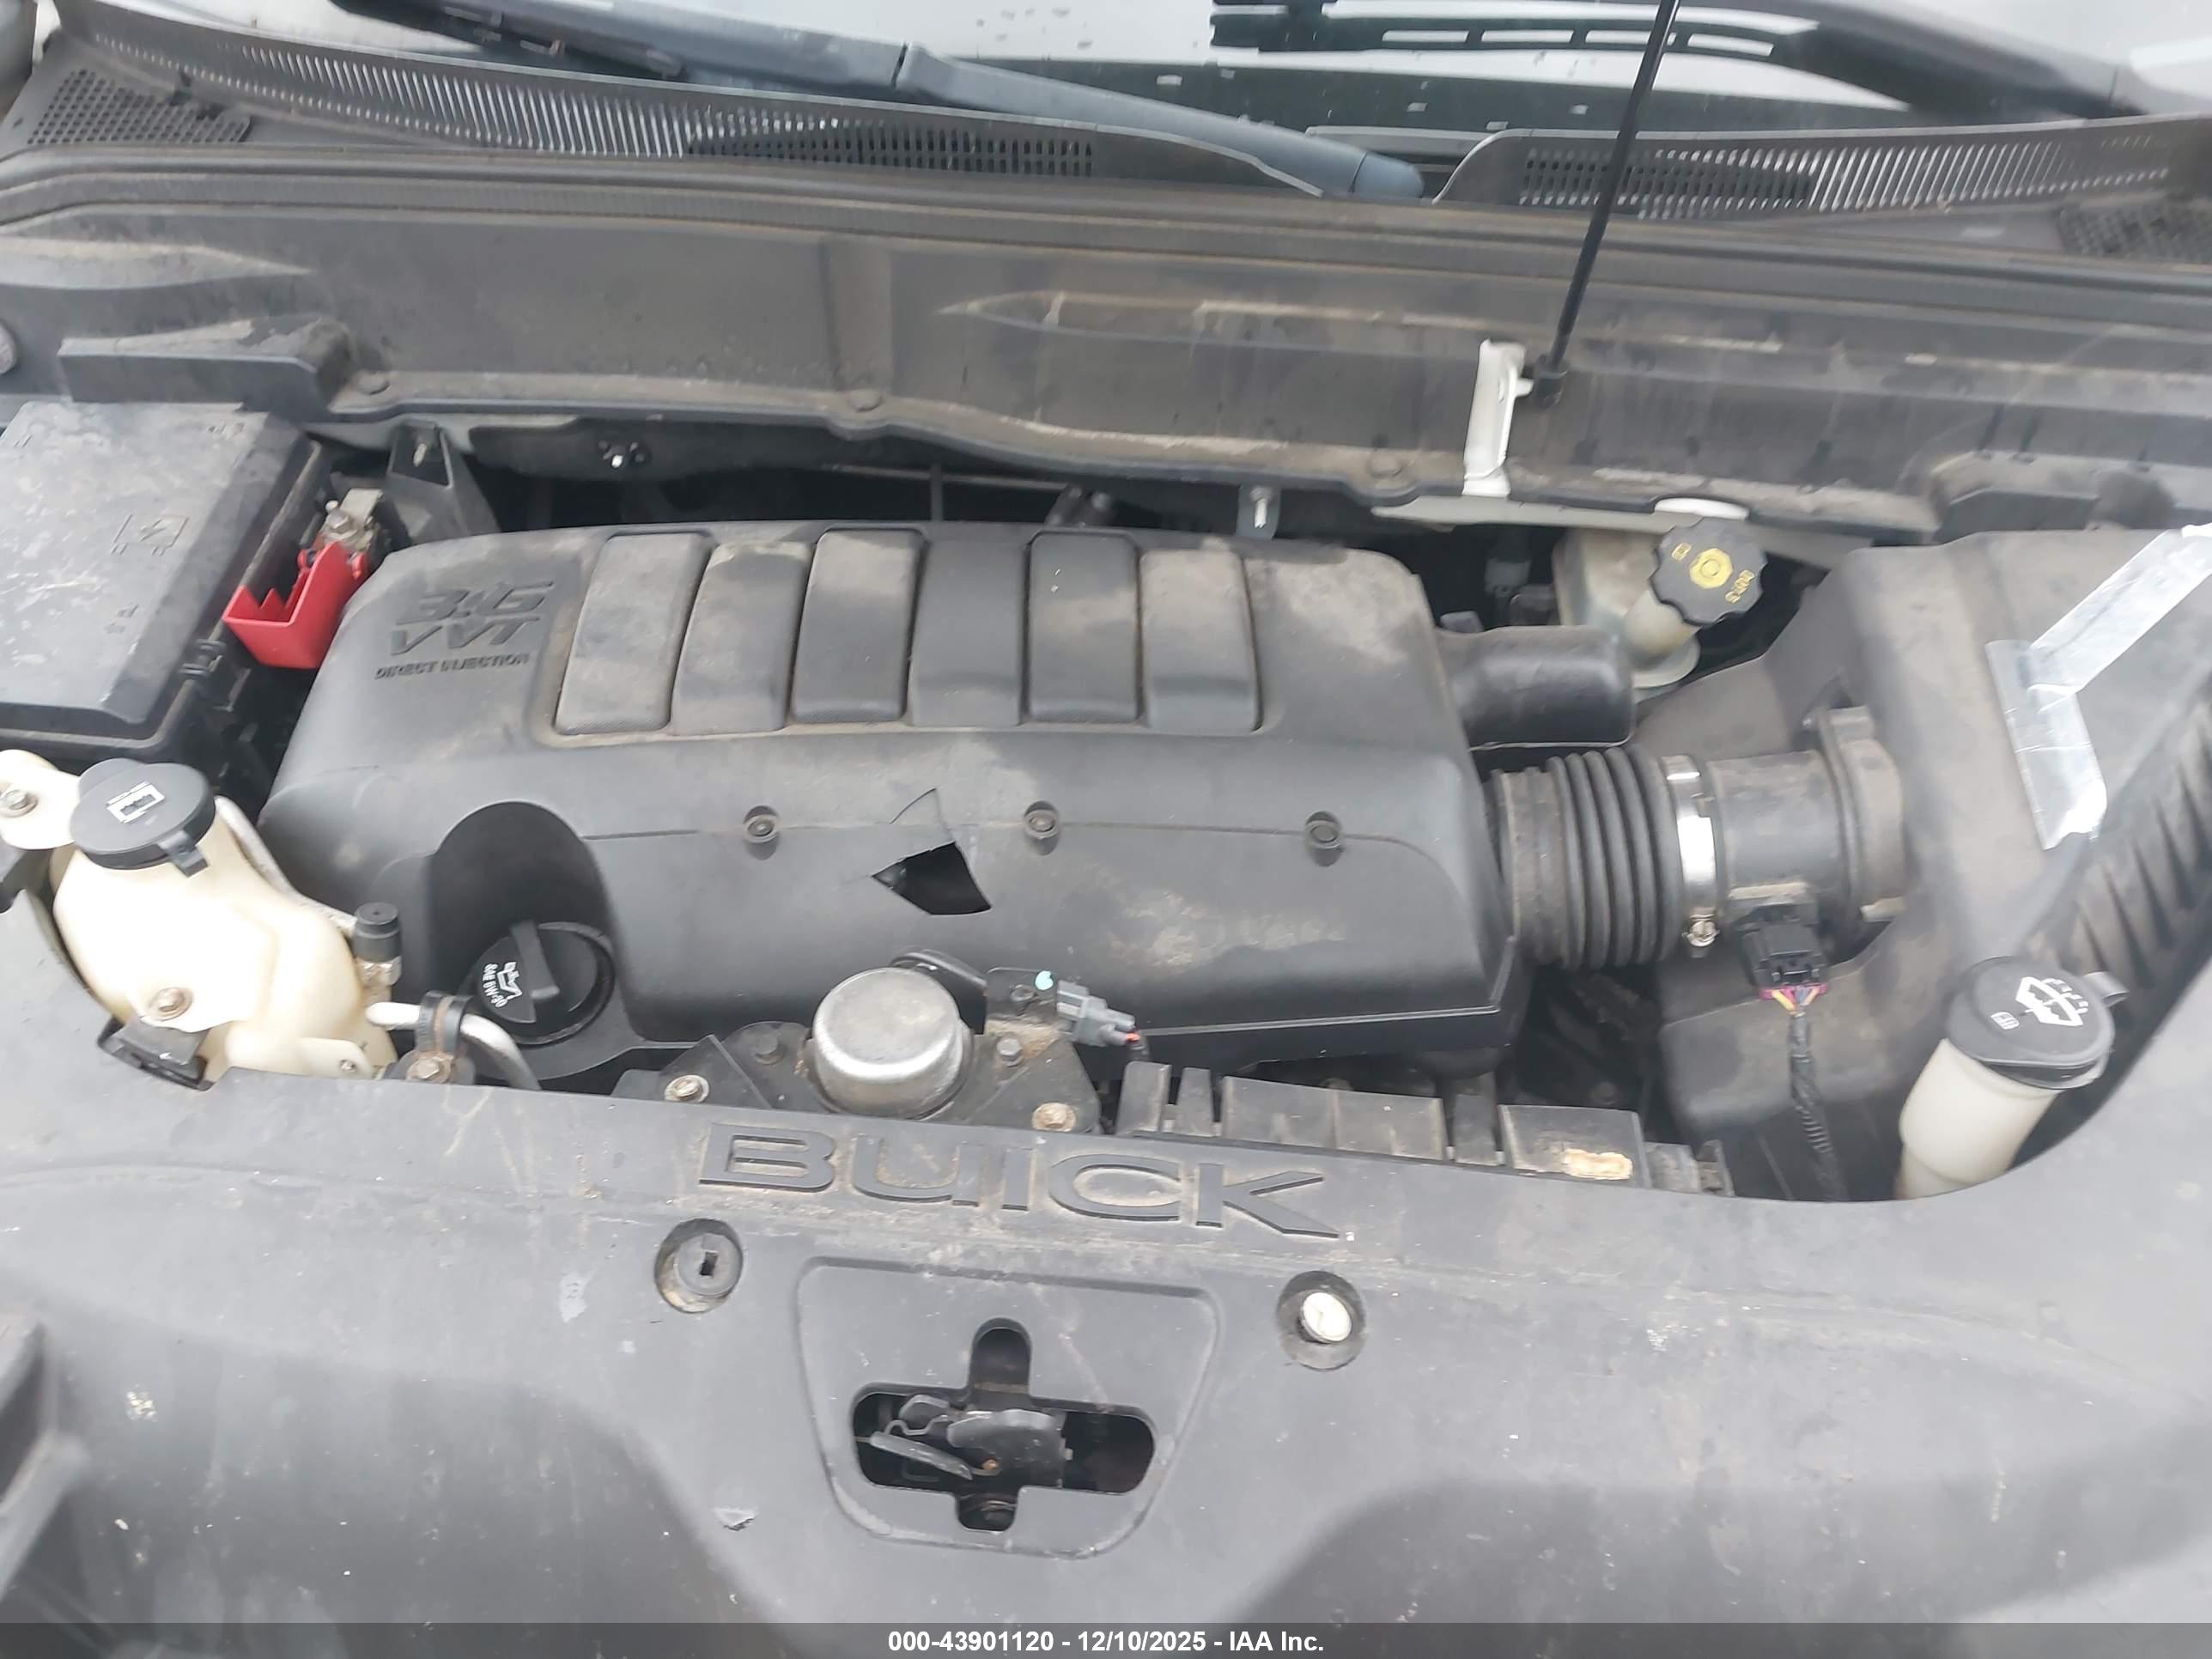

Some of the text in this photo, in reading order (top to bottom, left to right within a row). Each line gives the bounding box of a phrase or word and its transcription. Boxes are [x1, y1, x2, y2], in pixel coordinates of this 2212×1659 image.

[395, 580, 554, 626] 3.6
[390, 617, 541, 656] VVT
[374, 660, 440, 681] DIRECT
[440, 653, 530, 672] INJECTION
[698, 1122, 1340, 1240] BUICK
